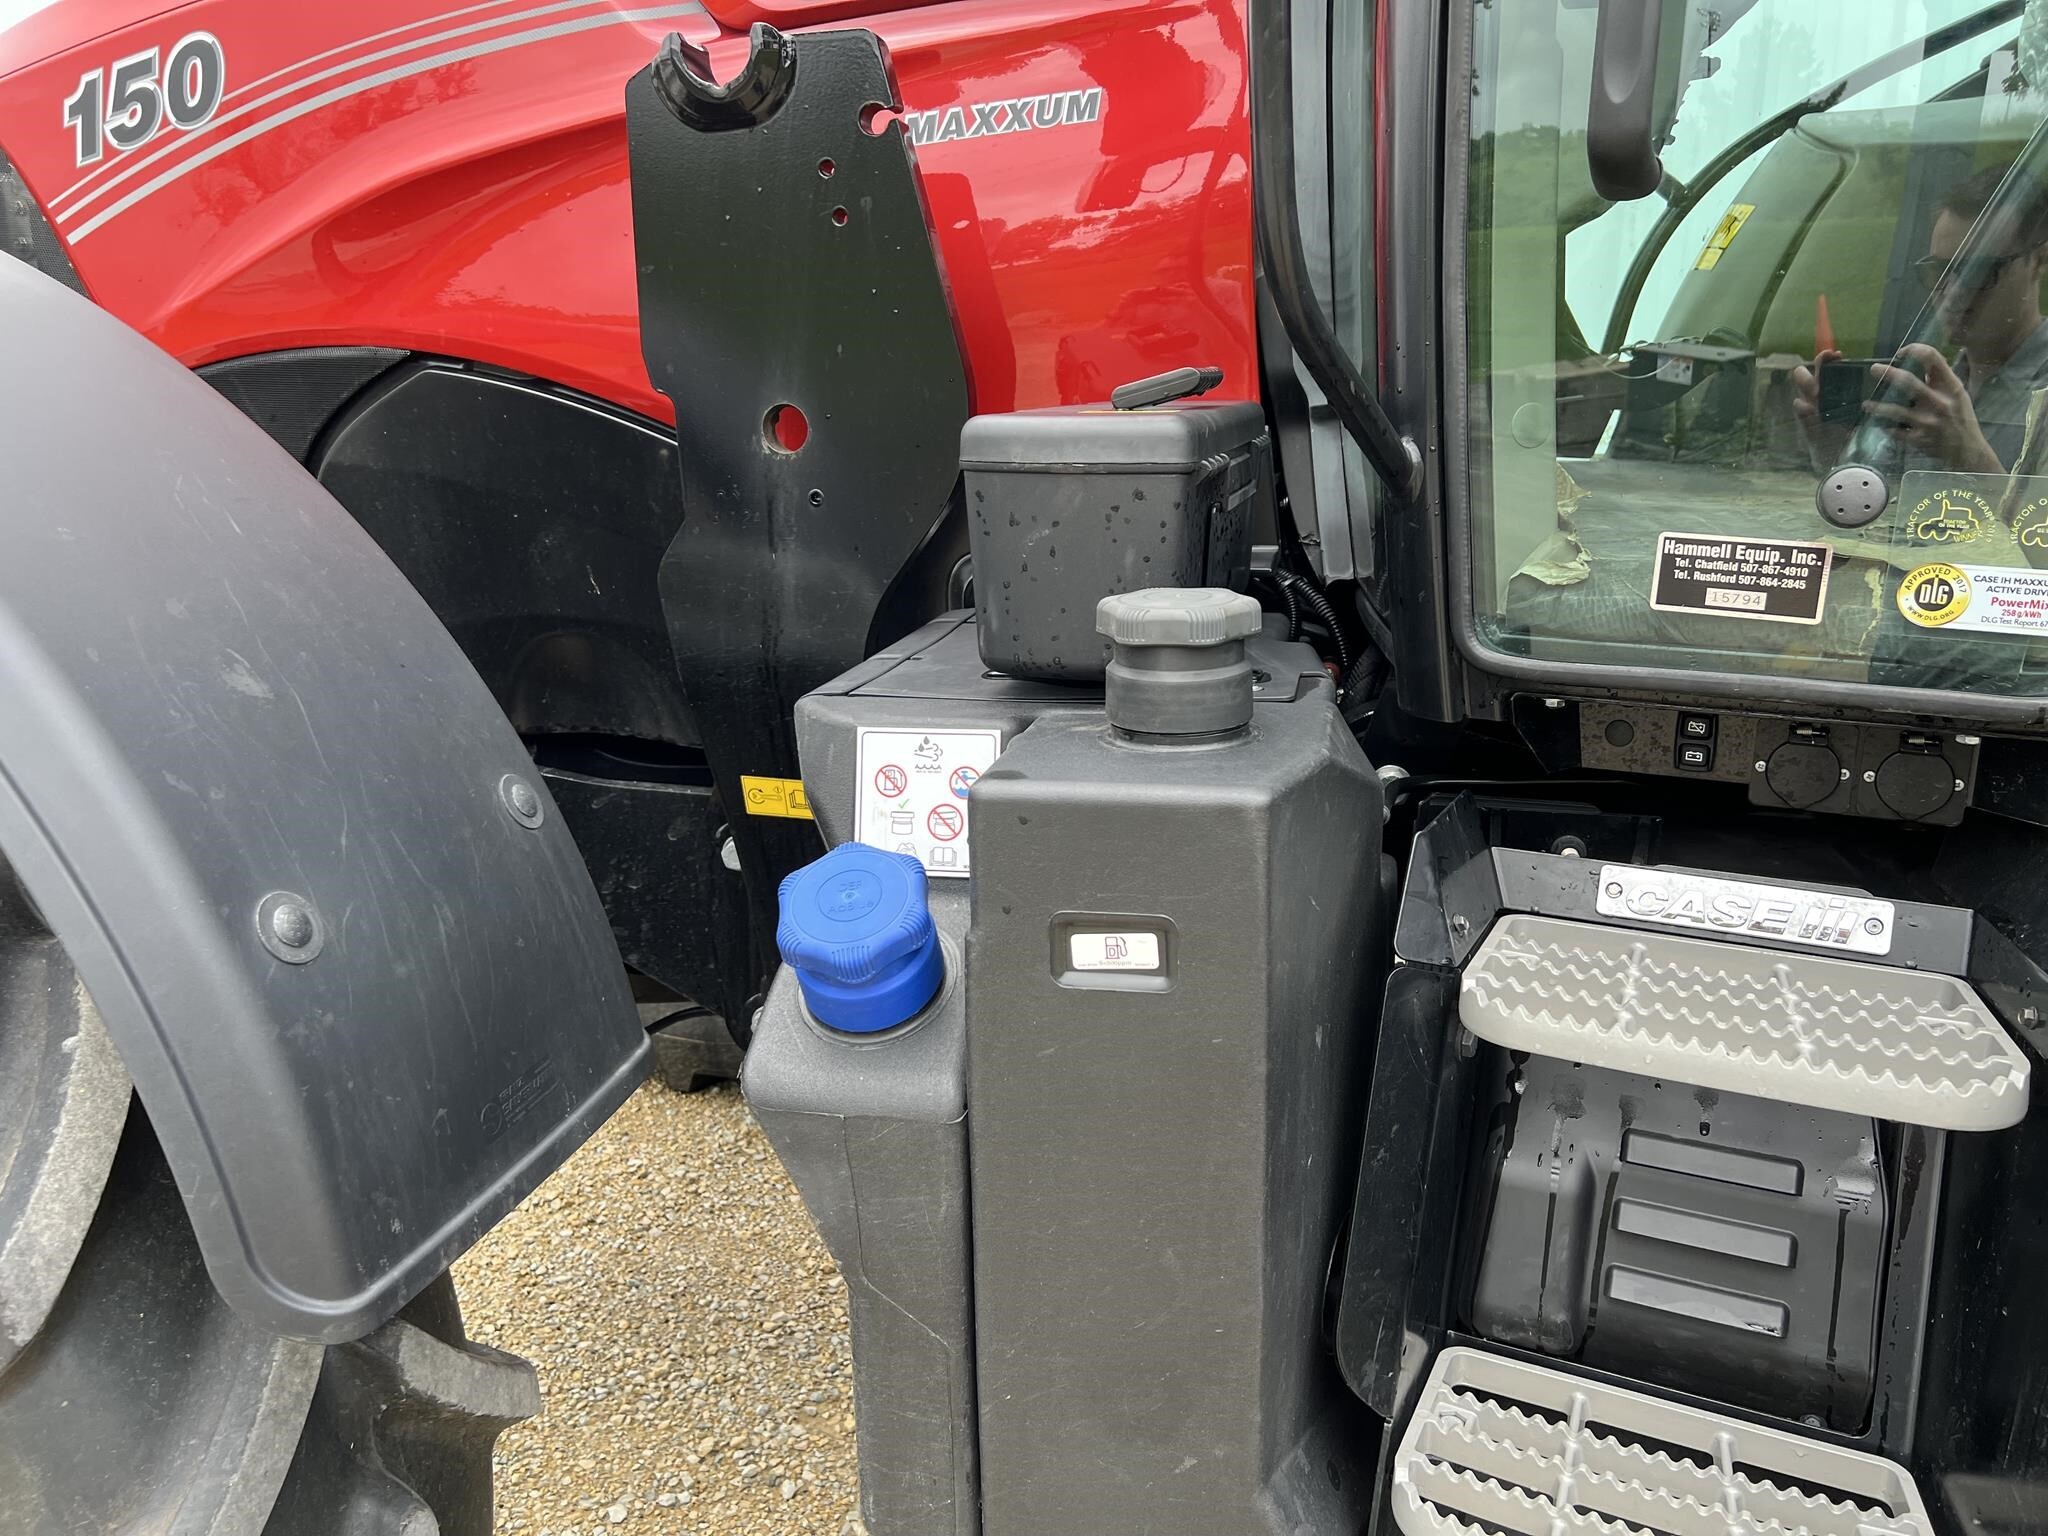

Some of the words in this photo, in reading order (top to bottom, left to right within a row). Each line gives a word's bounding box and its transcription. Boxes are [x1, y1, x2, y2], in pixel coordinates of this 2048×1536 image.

[63, 31, 225, 168] 150
[904, 87, 1102, 145] MAXXUM
[1906, 498, 1931, 540] TRACTOR
[1934, 490, 1948, 500] OF
[1952, 489, 1973, 500] THE
[1664, 539, 1732, 559] Hammell
[1735, 545, 1785, 565] Equip.
[1791, 549, 1822, 566] Inc.
[1673, 569, 1691, 580] Tel.
[1693, 571, 1737, 583] Rushford
[1738, 575, 1806, 589] 507-864-2845
[1675, 557, 1692, 568] Tel.
[1695, 559, 1738, 571] Chatfield
[1740, 563, 1809, 577] 507-867-4910
[1904, 567, 1951, 590] APPROVED
[1952, 575, 1967, 593] 2017
[1973, 575, 1999, 583] CASE
[1712, 591, 1762, 606] 15794
[1919, 574, 1949, 605] DLG
[1986, 586, 2022, 595] ACTIVE
[2024, 588, 2048, 596] DRIV
[2014, 619, 2038, 627] Report
[1625, 884, 1797, 936] CASE
